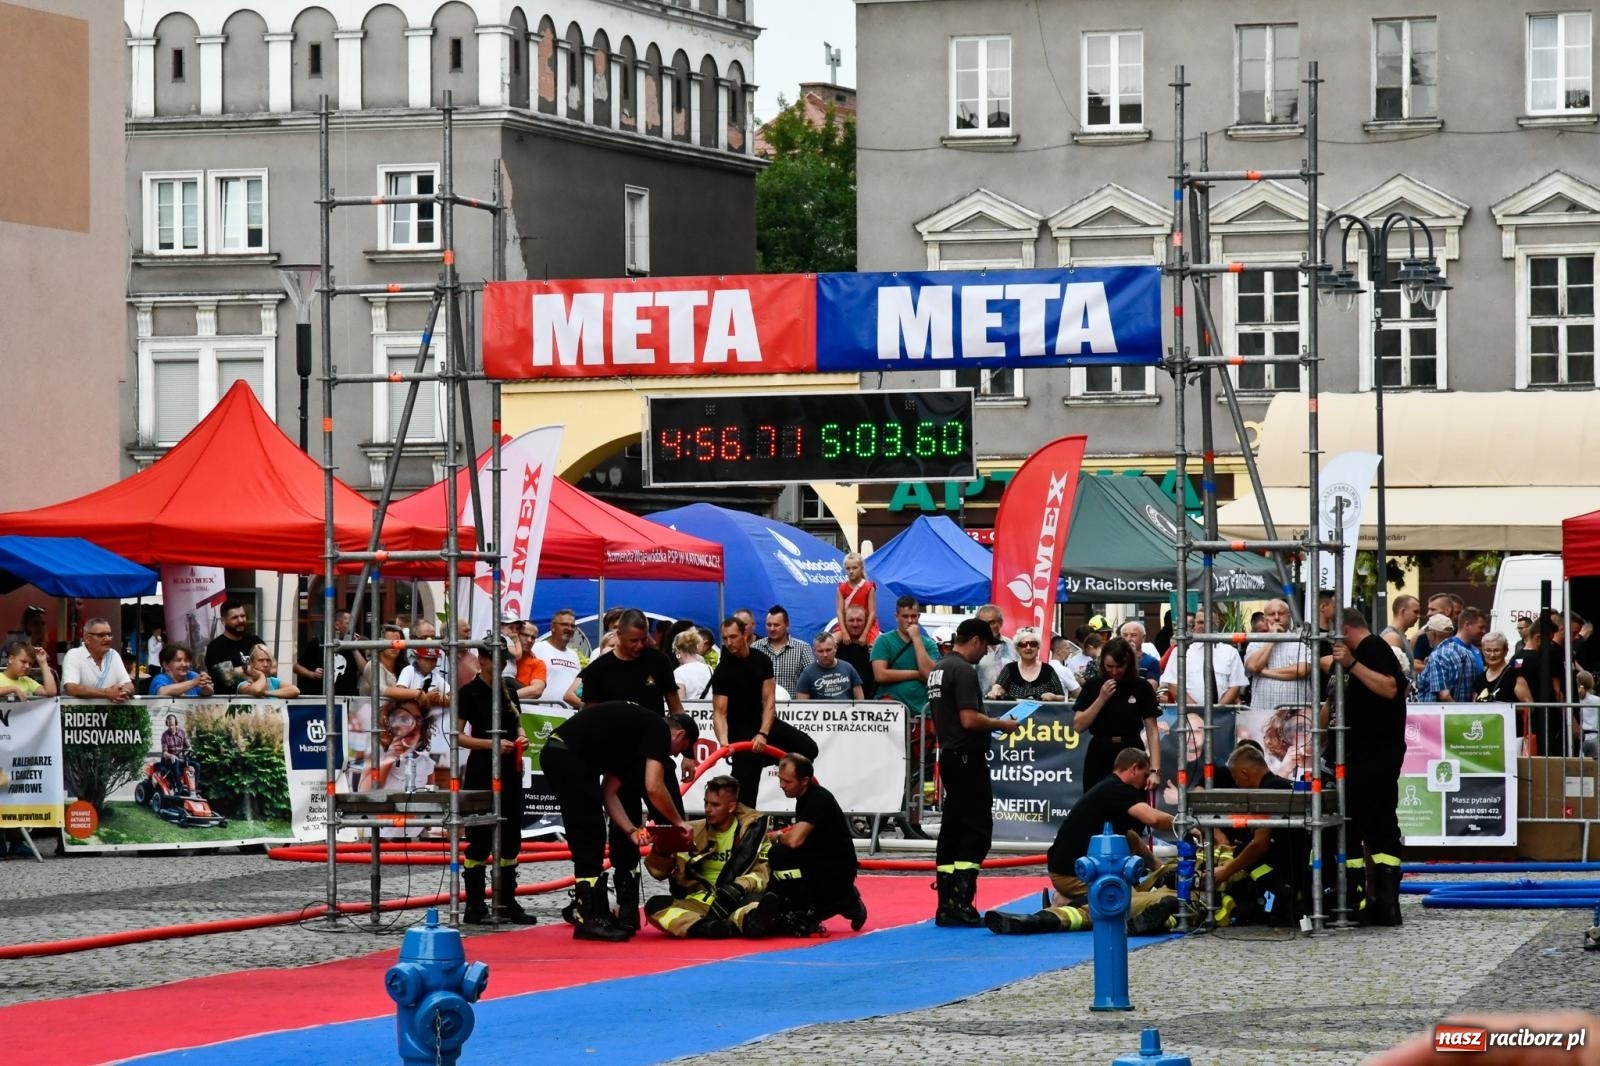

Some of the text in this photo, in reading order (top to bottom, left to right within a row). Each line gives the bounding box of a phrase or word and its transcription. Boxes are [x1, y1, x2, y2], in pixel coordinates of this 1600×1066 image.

[531, 289, 762, 366] META
[876, 281, 1119, 361] META
[661, 425, 801, 460] 4:56.71
[821, 421, 963, 458] 5:03.60
[1065, 576, 1174, 593] dy Raciborskie
[64, 712, 109, 728] RIDERY
[822, 710, 848, 722] DLA
[851, 708, 899, 723] STRAŻY
[826, 721, 889, 733] STRAŻACKICH
[999, 717, 1080, 750] płaty
[64, 729, 143, 746] HUSQVARNA
[299, 744, 327, 753] Husqva
[1000, 745, 1036, 761] kart
[12, 755, 52, 768] KALENDARZE
[988, 764, 1073, 786] ultiSport
[8, 783, 43, 794] FIRMOWE
[310, 793, 327, 803] RE-W
[992, 798, 1047, 813] ENEFITY
[1451, 796, 1501, 806] Masz pytania?
[308, 805, 327, 814] Racibó
